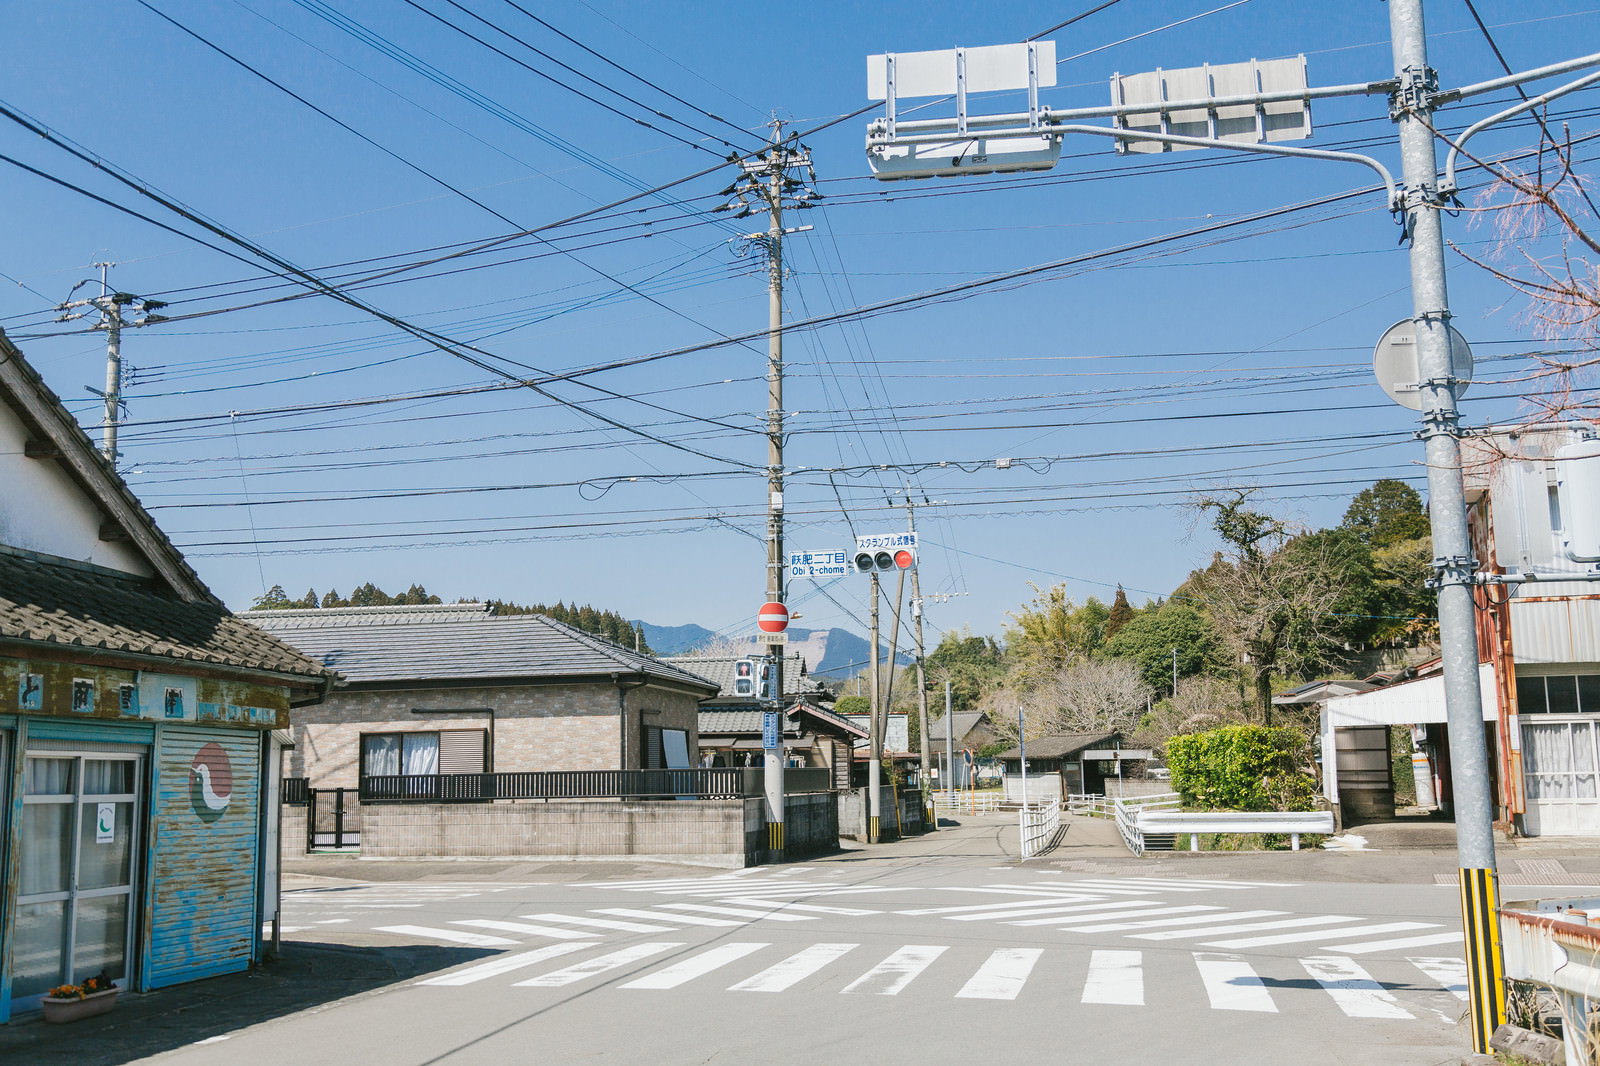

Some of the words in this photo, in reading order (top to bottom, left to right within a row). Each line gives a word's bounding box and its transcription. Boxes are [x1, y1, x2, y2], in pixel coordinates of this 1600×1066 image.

[859, 535, 916, 549] スクランブル式信号
[792, 566, 806, 576] Obi
[809, 565, 845, 575] 2-chome
